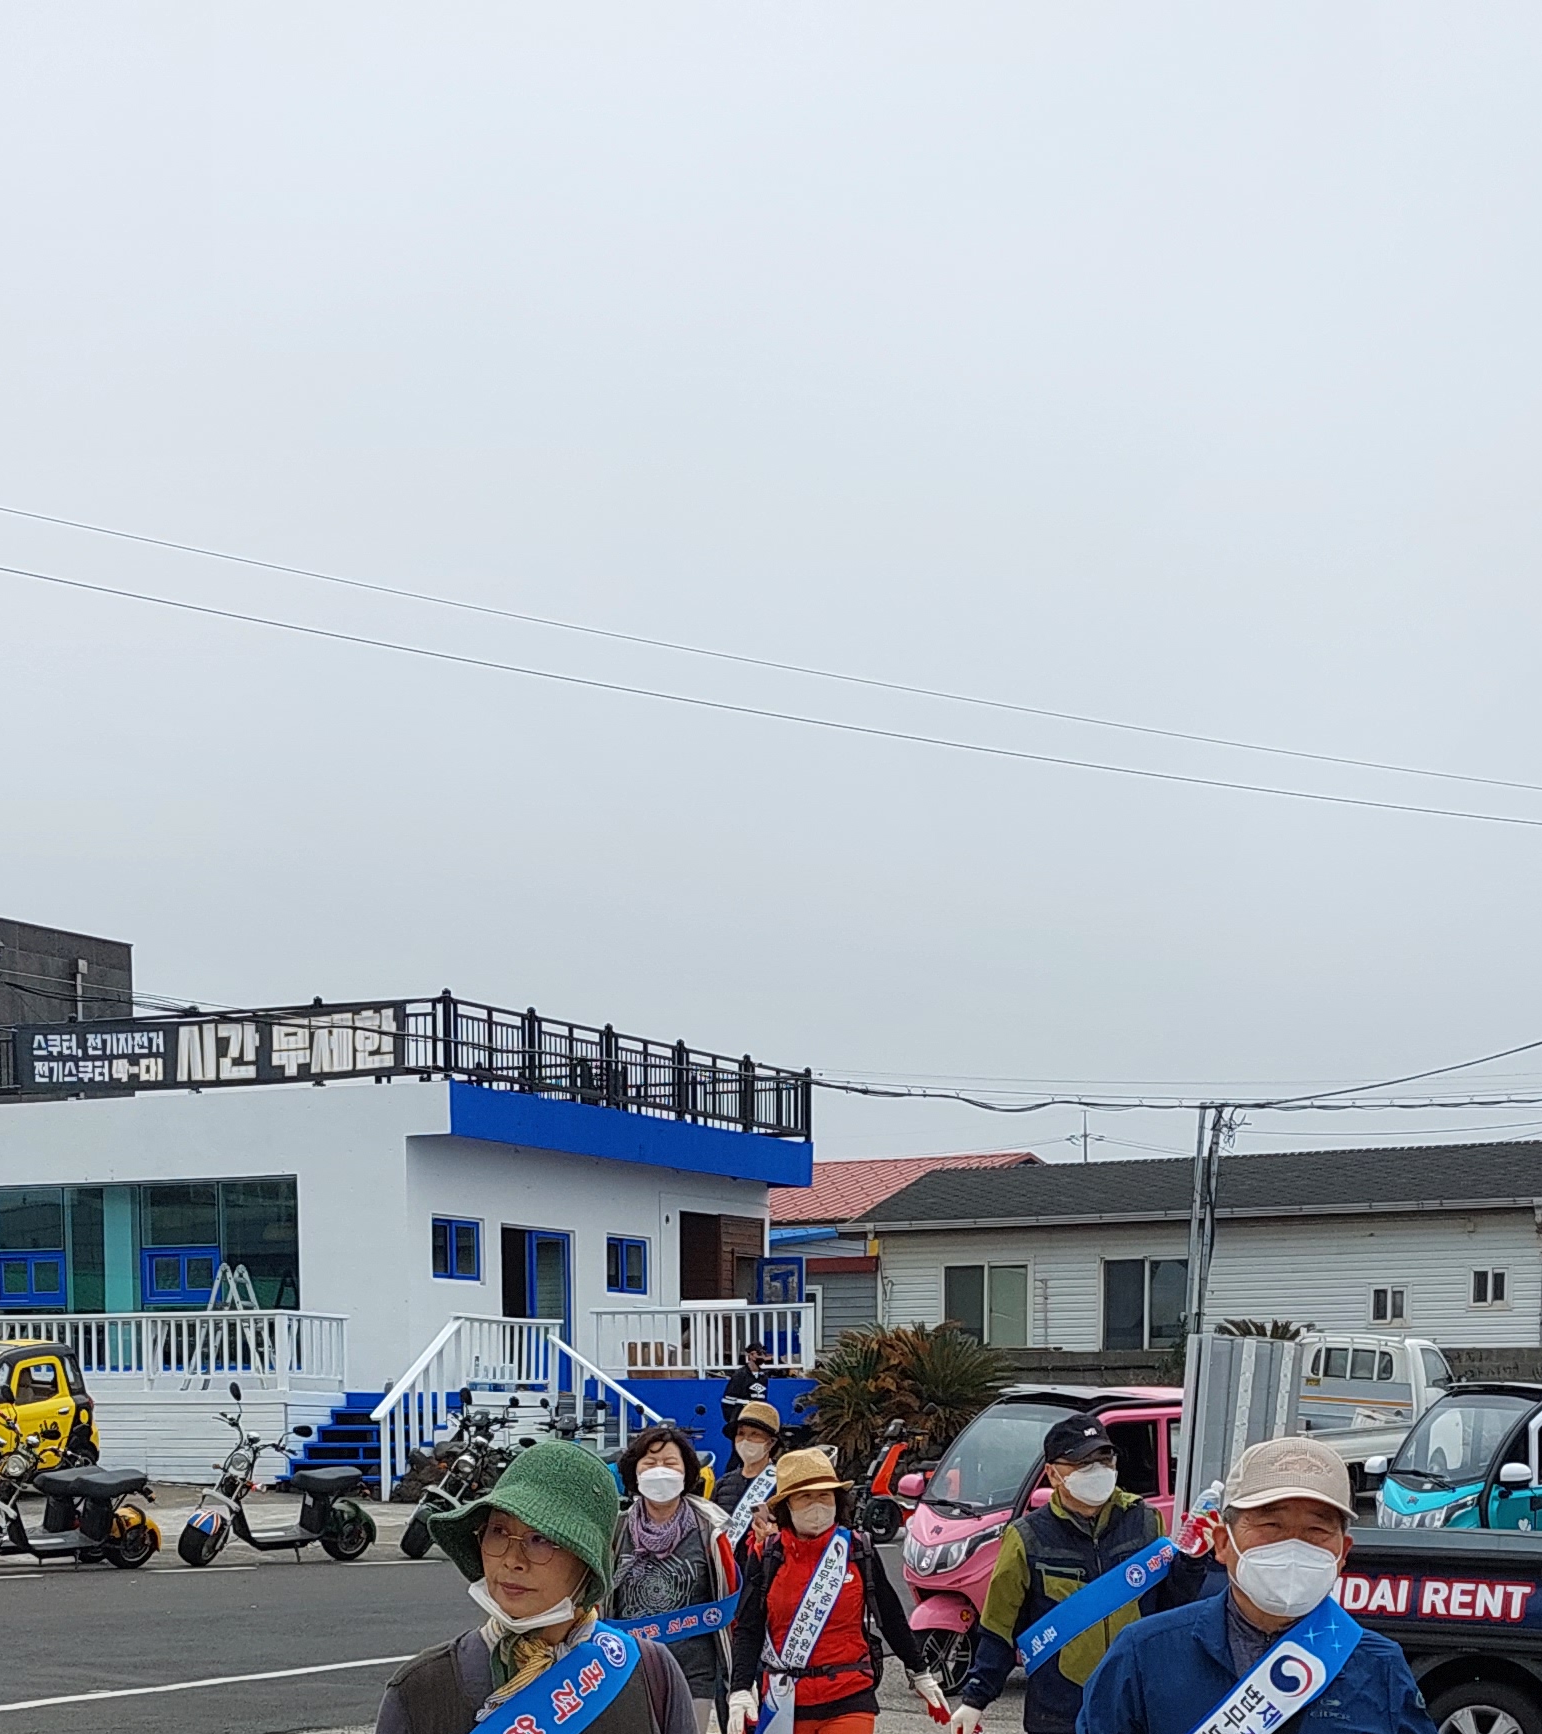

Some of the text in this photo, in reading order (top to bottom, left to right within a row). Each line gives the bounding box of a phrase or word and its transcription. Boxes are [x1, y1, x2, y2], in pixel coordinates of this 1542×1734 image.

[33, 1030, 165, 1057] 스쿠터, 전기자전거
[271, 1008, 396, 1077] 무제한
[33, 1060, 109, 1083] 전기스쿠터
[1422, 1580, 1533, 1619] RENT
[550, 1658, 608, 1726] 폭력
